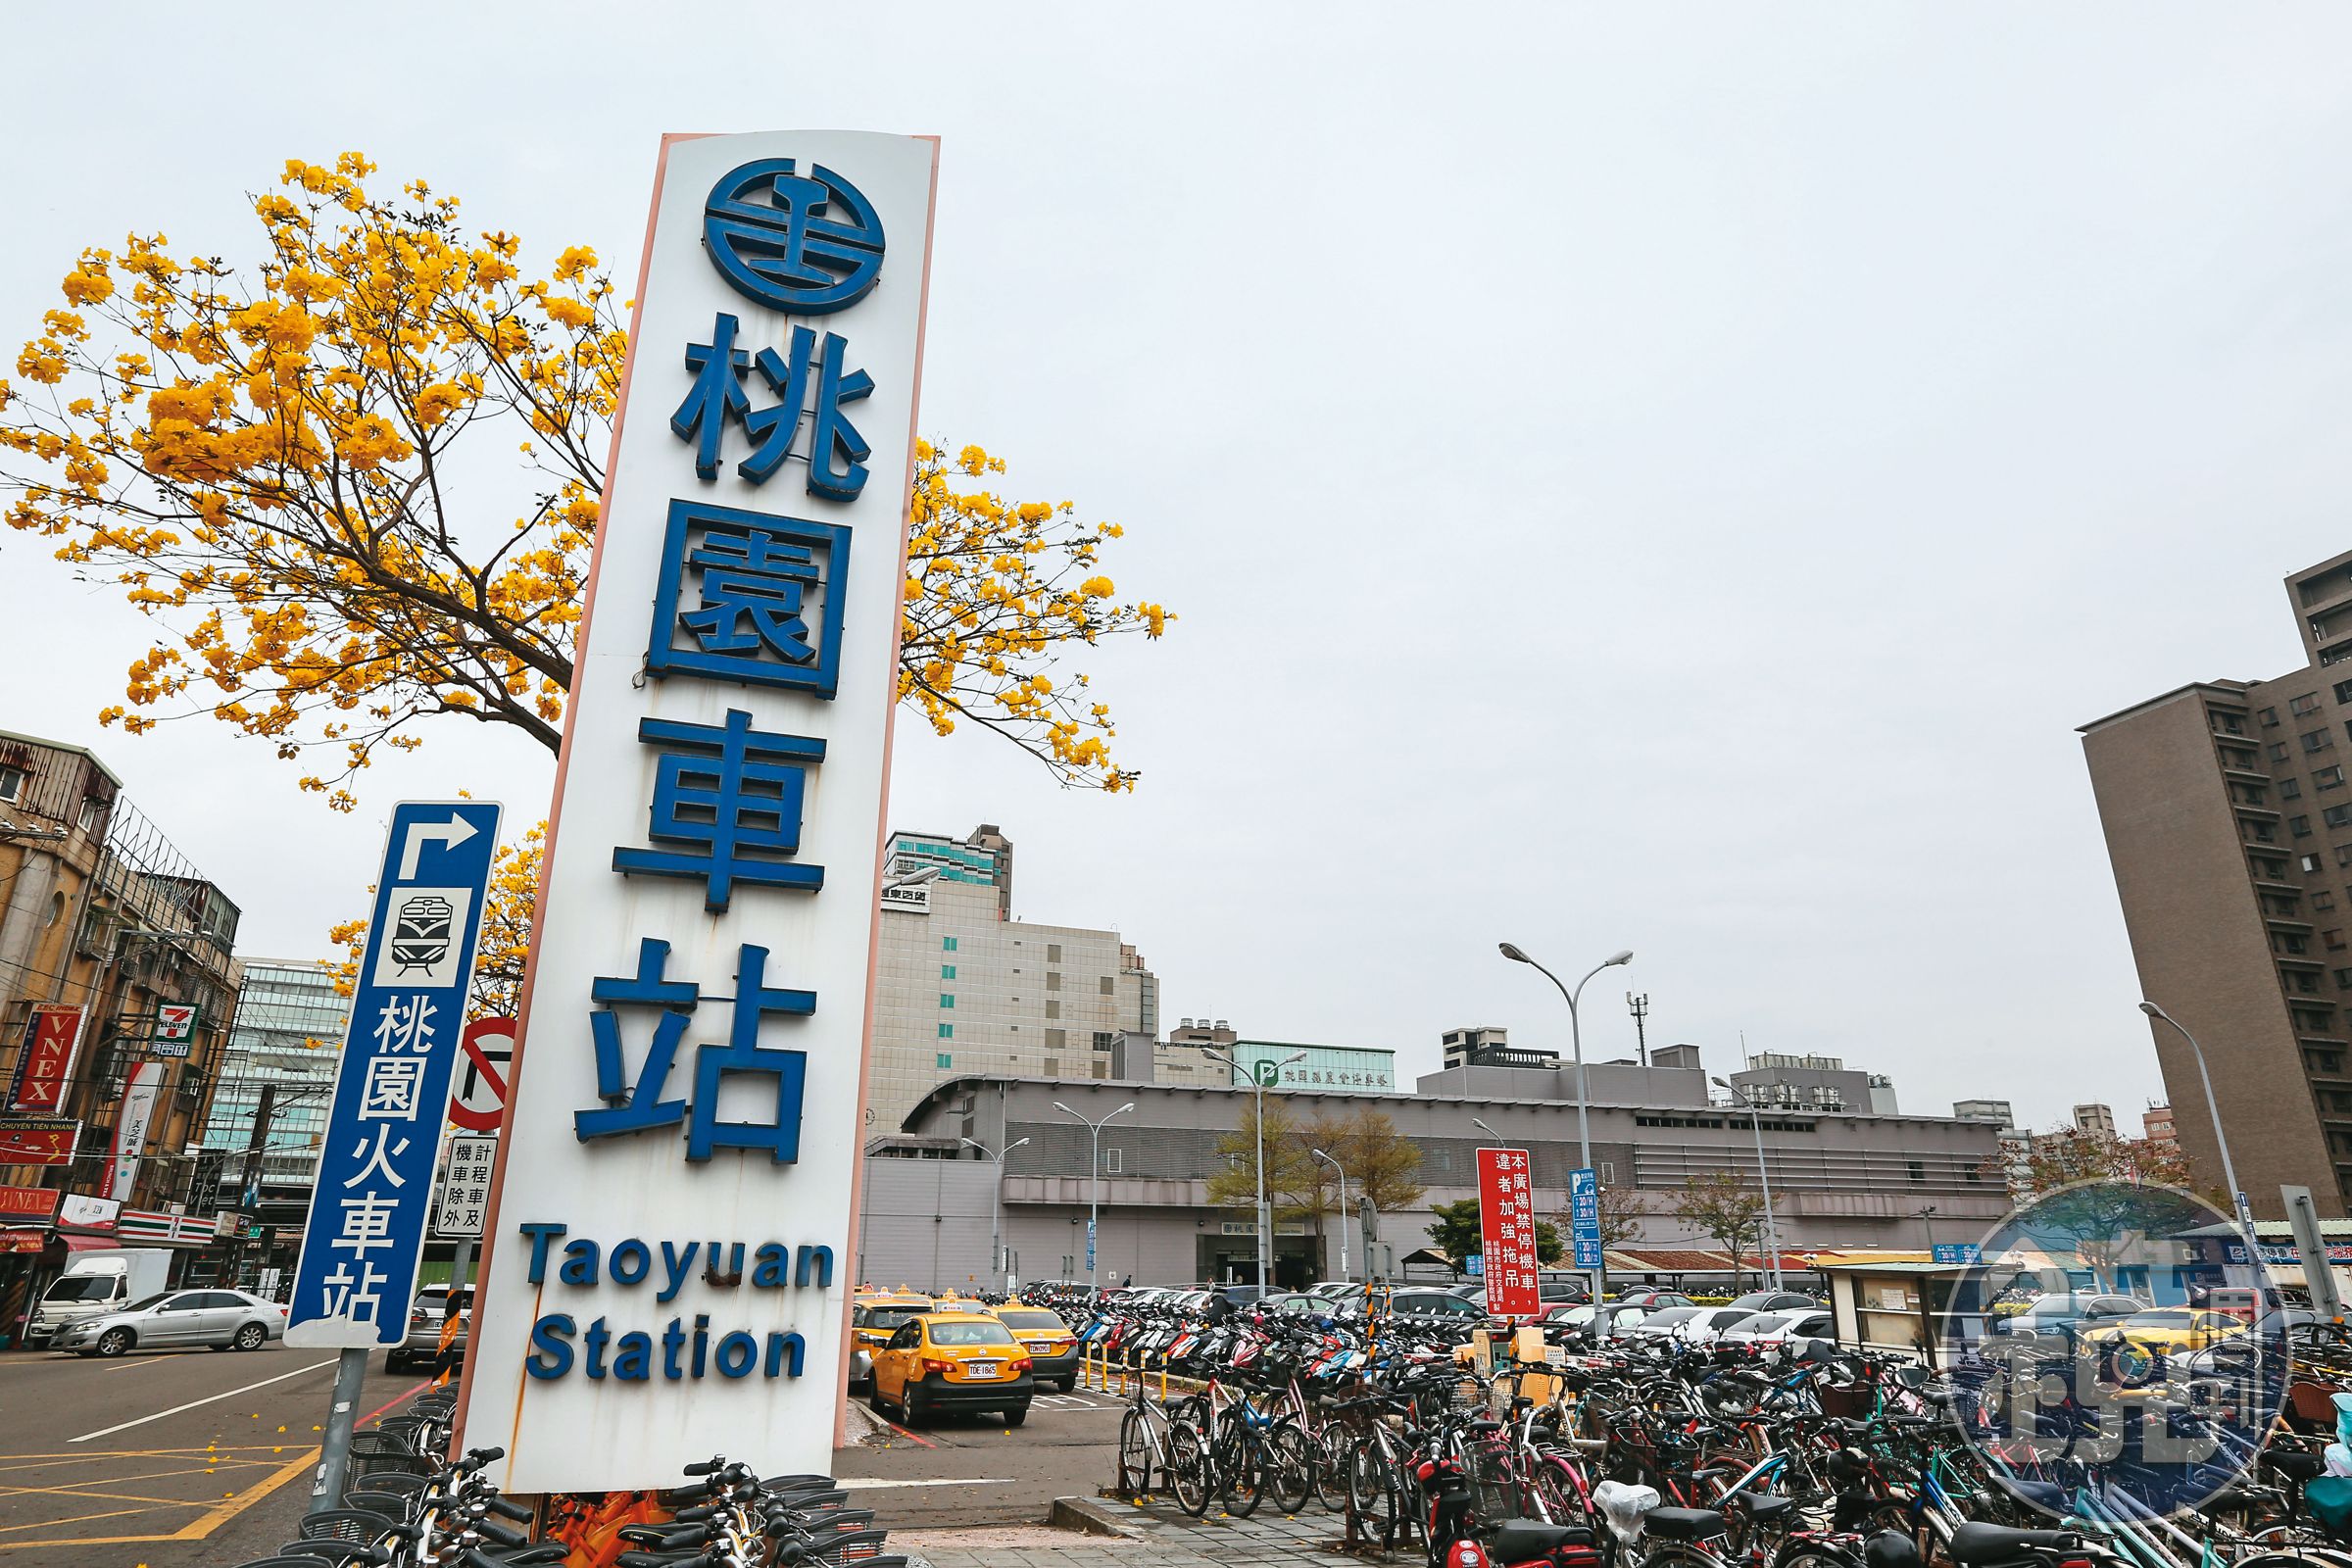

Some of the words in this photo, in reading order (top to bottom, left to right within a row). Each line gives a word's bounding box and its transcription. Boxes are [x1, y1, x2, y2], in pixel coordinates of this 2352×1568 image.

[574, 312, 876, 1166] 桃園車站
[26, 1015, 72, 1101] VNEX
[322, 994, 437, 1329] 桃園火車站
[443, 1144, 472, 1228] 機車除外
[465, 1144, 492, 1227] 計程車及
[1572, 1172, 1582, 1195] P
[1579, 1197, 1593, 1206] 20/H
[1580, 1207, 1594, 1217] 30/H
[518, 1221, 835, 1302] Taoyuan
[523, 1313, 807, 1382] Station
[970, 1365, 997, 1376] TDE-1865
